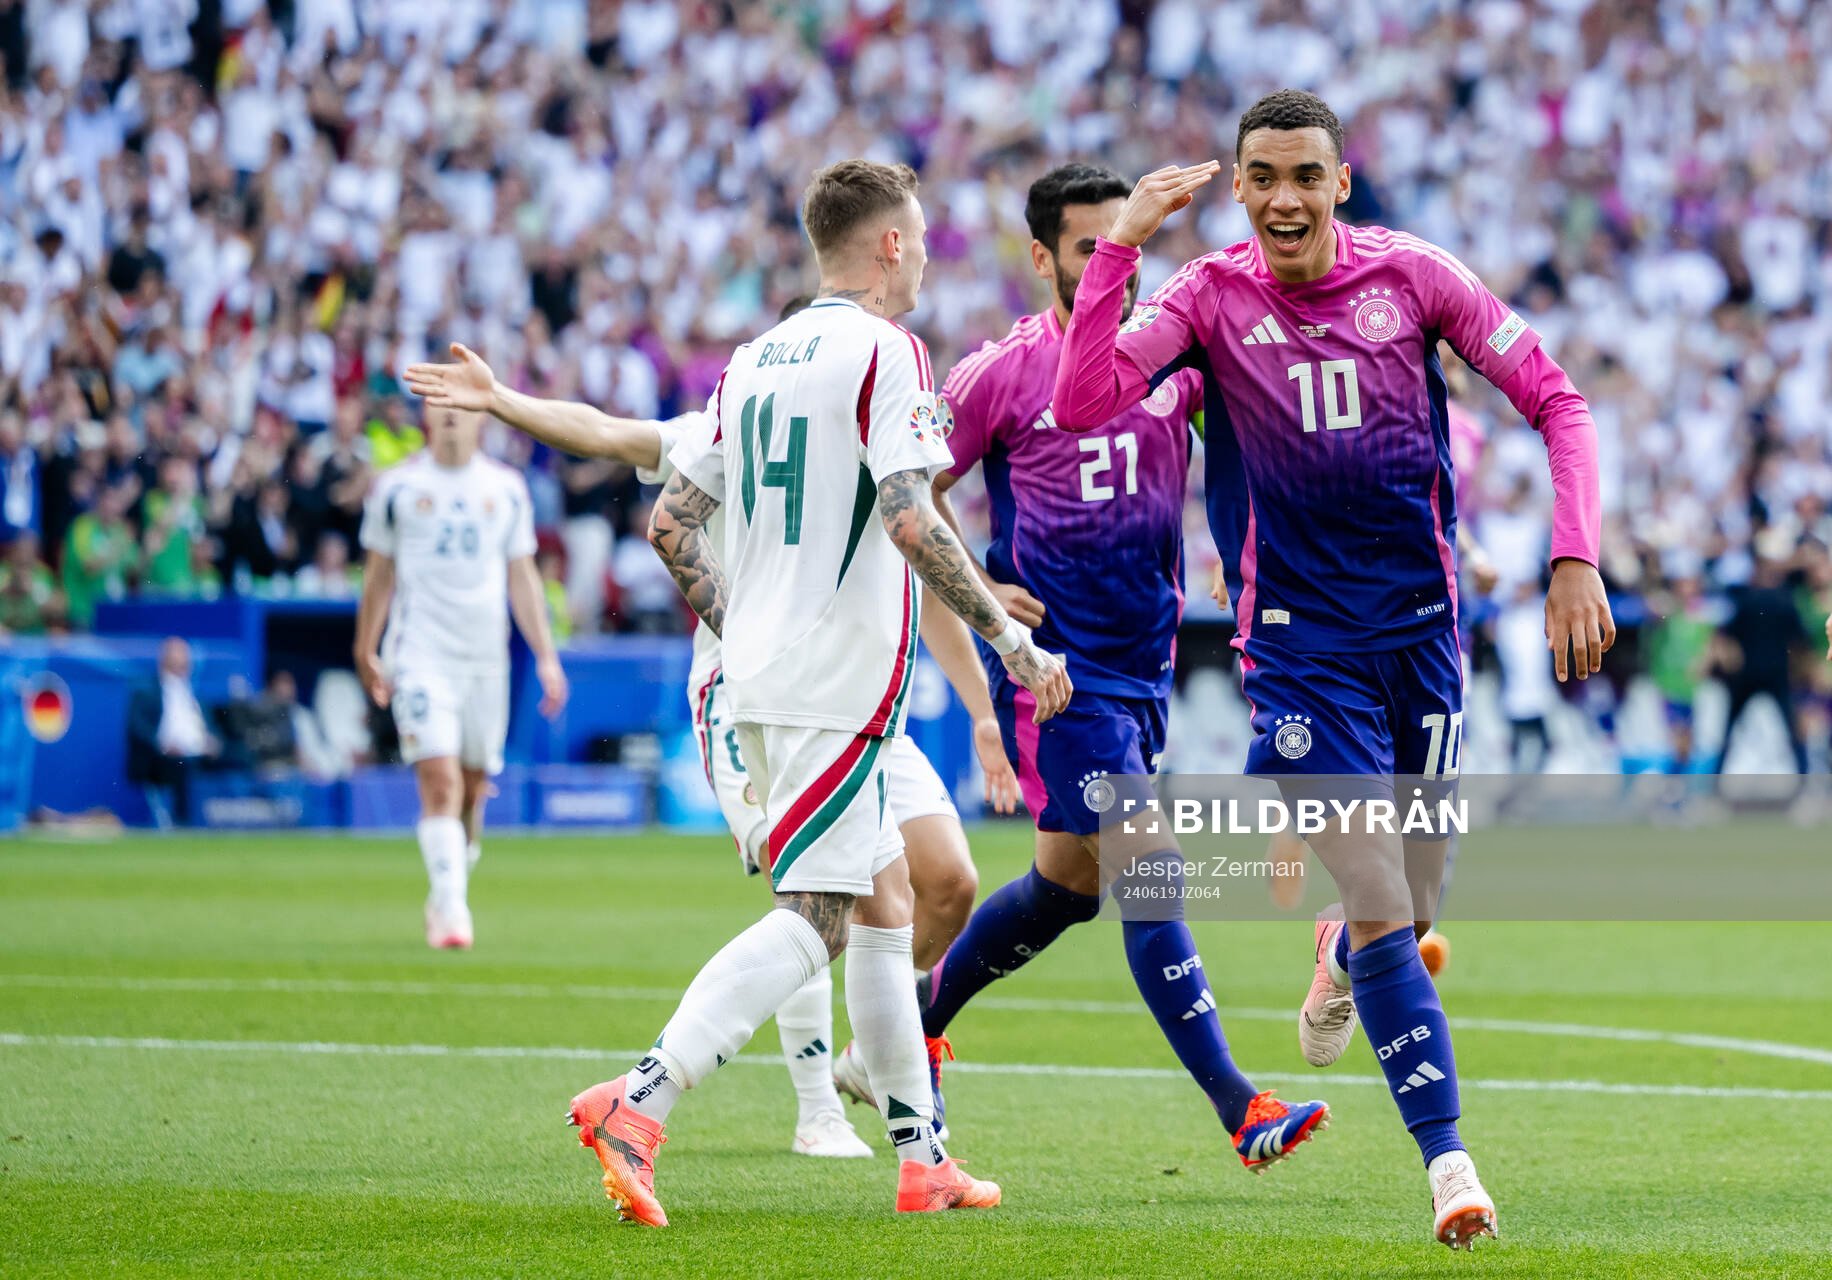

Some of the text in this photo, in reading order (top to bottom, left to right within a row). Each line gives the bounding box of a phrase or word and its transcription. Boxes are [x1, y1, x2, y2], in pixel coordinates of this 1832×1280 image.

[757, 335, 822, 368] BOLLA
[1288, 358, 1362, 432] 10
[740, 392, 809, 545] 14
[1078, 432, 1138, 502] 21
[434, 519, 480, 557] 20
[1422, 711, 1463, 781] 10
[1163, 954, 1202, 981] DFB
[1378, 1025, 1432, 1060] DFB
[646, 1069, 669, 1090] TAPE
